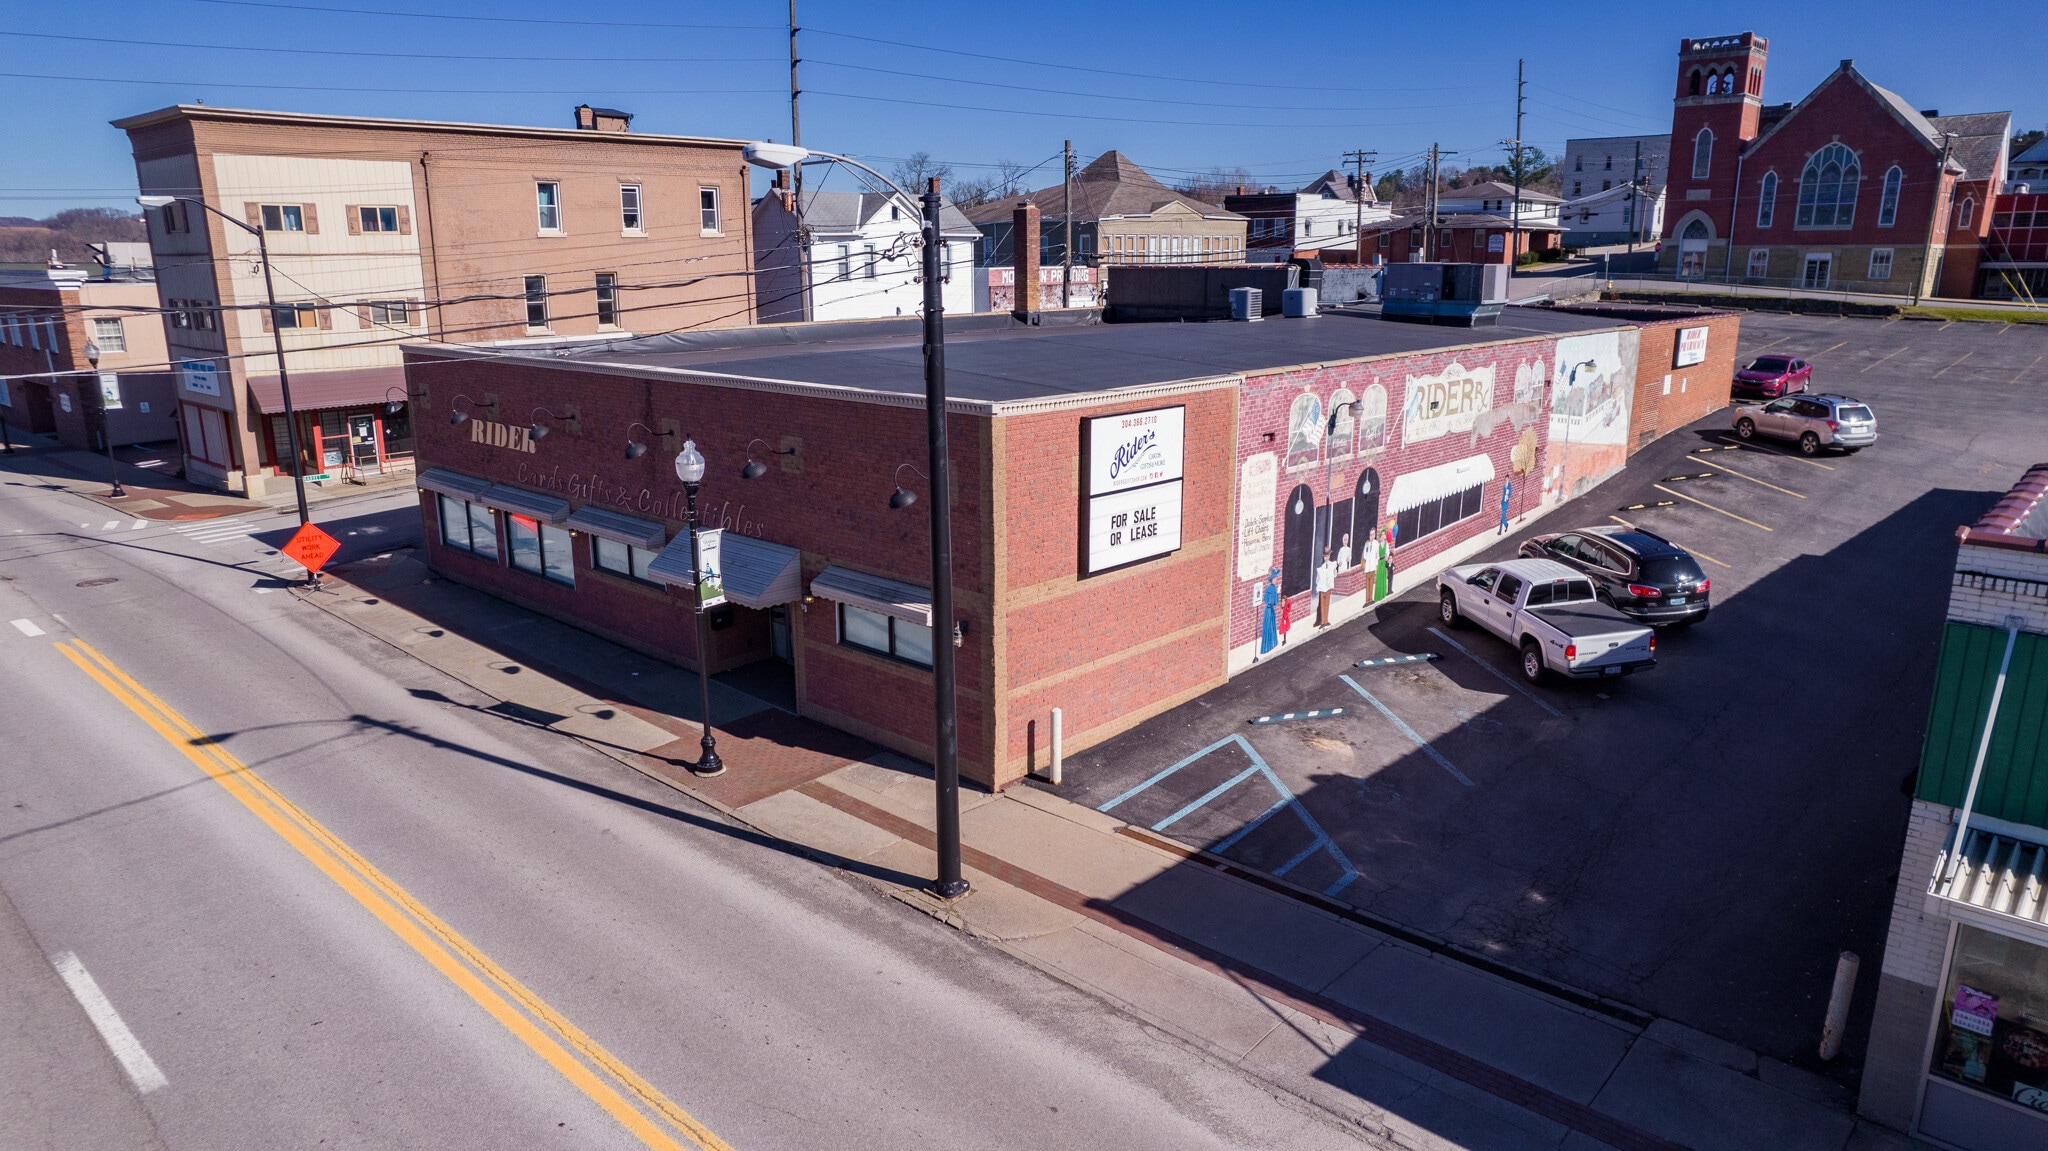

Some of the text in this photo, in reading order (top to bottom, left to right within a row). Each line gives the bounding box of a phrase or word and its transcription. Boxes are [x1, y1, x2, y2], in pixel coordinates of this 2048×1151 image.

[1051, 269, 1089, 283] PRTING
[1417, 377, 1474, 421] RIDER
[1110, 429, 1156, 480] Rider's
[518, 462, 563, 491] Cards
[568, 473, 612, 505] Gifts
[616, 486, 634, 513] &
[1111, 506, 1156, 530] FOR SALE
[296, 534, 323, 543] UTILITY
[1110, 522, 1158, 546] OR LEASE
[301, 552, 324, 560] AHEAD
